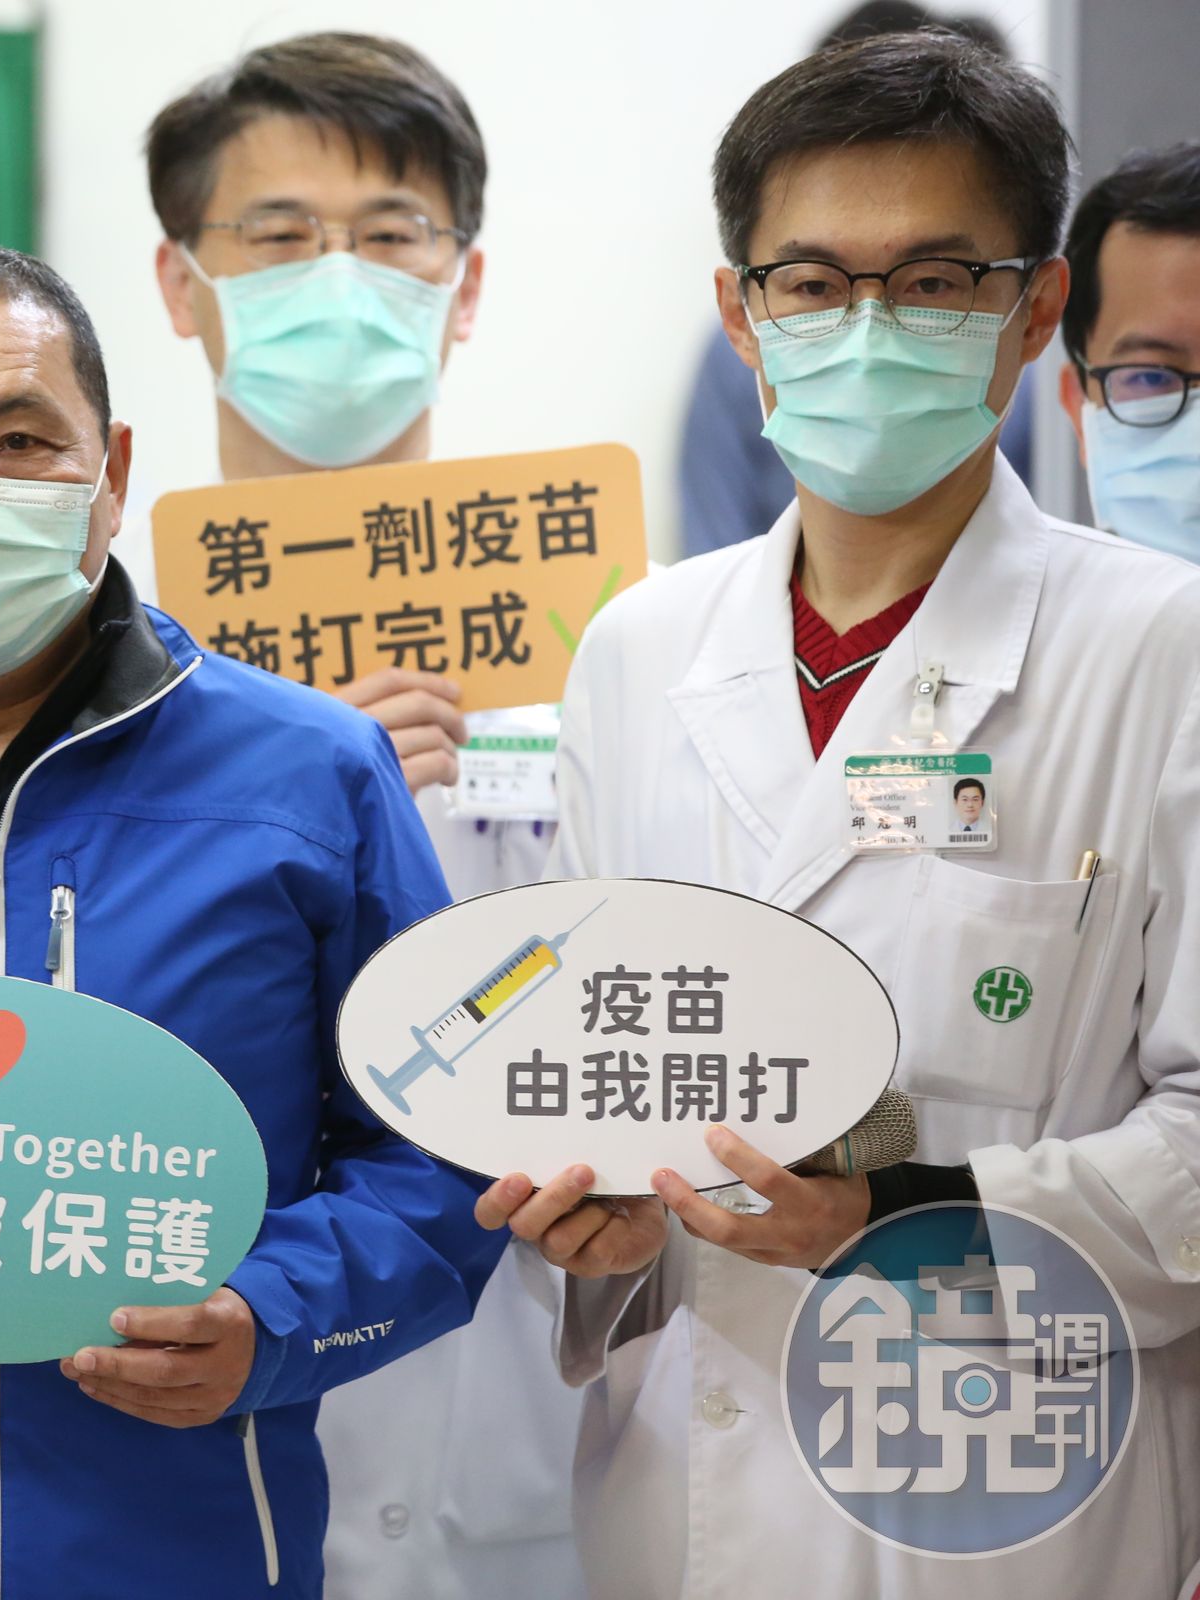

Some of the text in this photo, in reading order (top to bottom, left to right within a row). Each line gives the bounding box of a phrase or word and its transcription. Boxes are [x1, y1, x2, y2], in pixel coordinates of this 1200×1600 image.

[198, 481, 599, 596] 第一劑疫苗
[208, 591, 532, 688] 施打完成
[581, 964, 729, 1036] 疫苗
[507, 1049, 810, 1123] 由我開打
